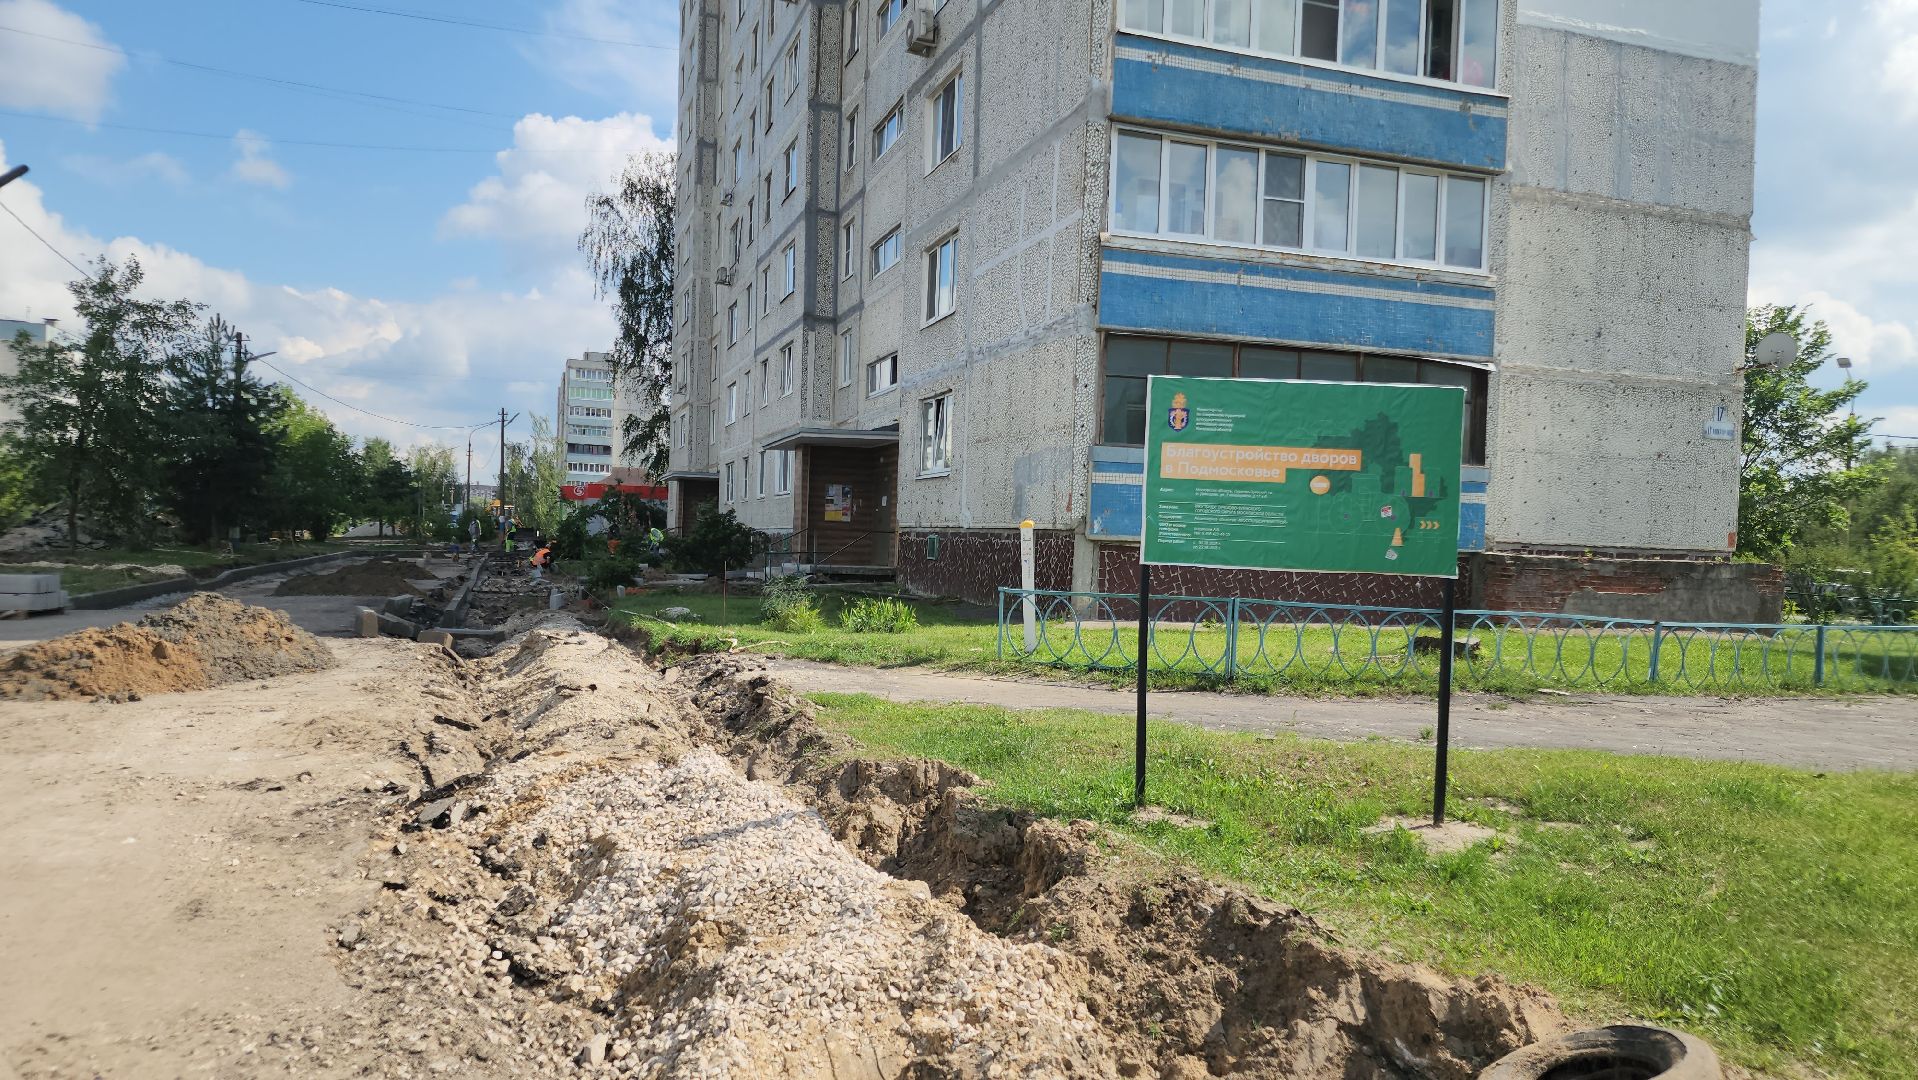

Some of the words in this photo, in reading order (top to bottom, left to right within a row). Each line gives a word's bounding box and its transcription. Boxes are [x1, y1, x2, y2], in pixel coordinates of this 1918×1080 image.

[1717, 406, 1726, 421] 17
[1166, 444, 1297, 463] Благоустройство
[1301, 453, 1358, 468] дворов
[1165, 463, 1173, 474] в
[1177, 461, 1280, 478] Подмосковье
